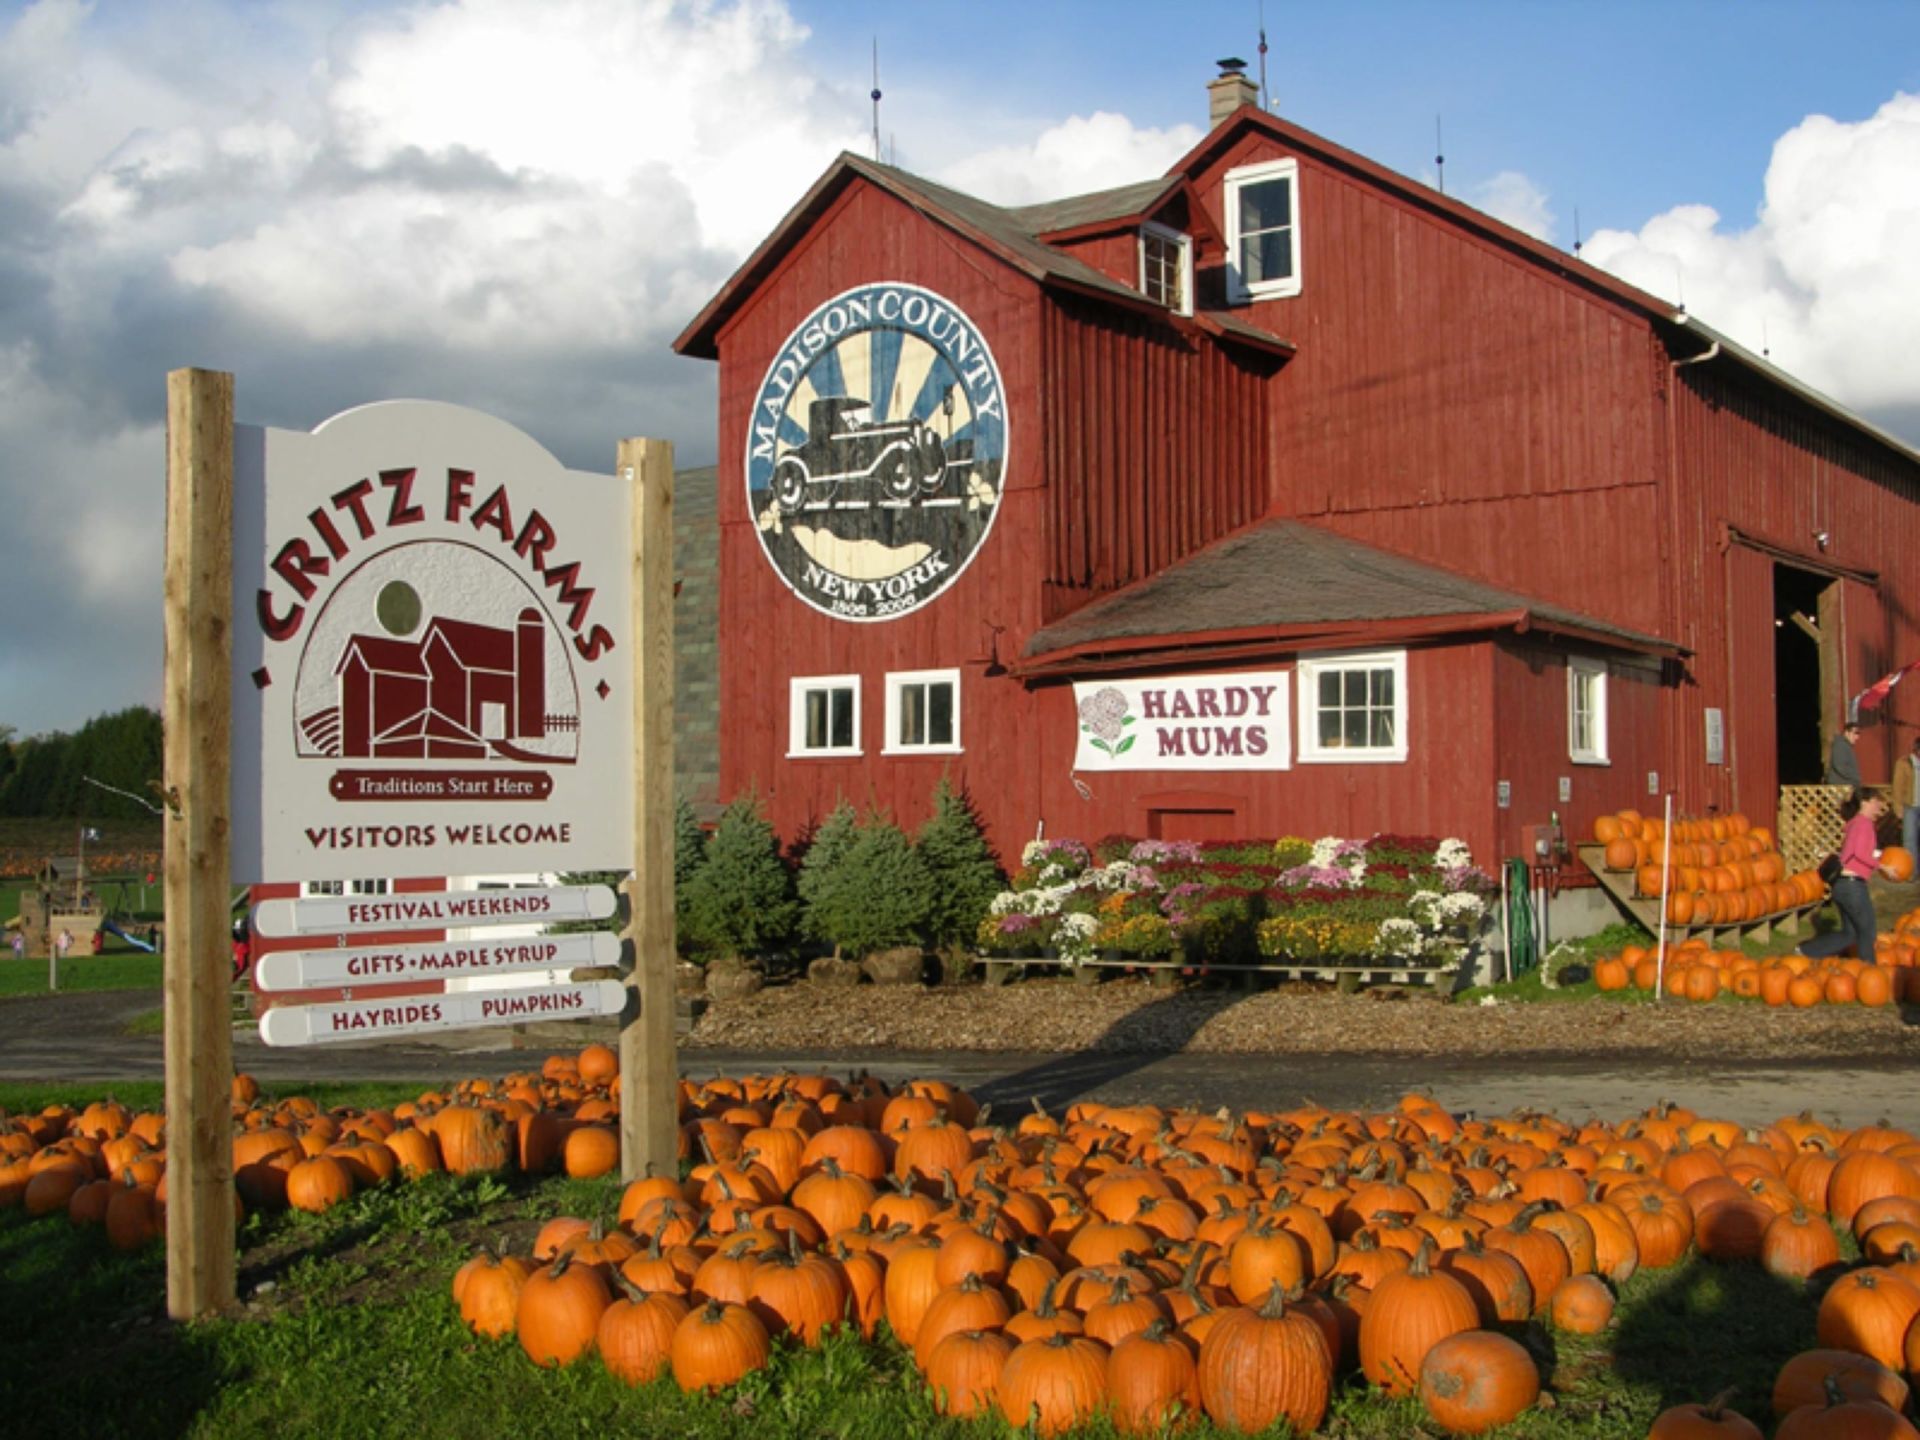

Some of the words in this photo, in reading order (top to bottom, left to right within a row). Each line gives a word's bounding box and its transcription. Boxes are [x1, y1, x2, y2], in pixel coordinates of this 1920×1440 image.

[753, 294, 874, 463] MADISON
[877, 290, 1002, 421] COUNTY
[257, 467, 425, 641] CRITZ
[445, 467, 615, 662] FARMS
[802, 561, 863, 601] NEW
[866, 549, 950, 601] YORK
[1140, 685, 1277, 719] HARDY
[1156, 725, 1269, 757] MUMS
[356, 778, 444, 794] Traditions
[448, 778, 489, 794] Start
[493, 779, 533, 794] Here
[305, 825, 436, 849] VISITORS
[445, 823, 571, 846] WELCOME
[348, 901, 444, 923] FESTIVAL
[447, 895, 551, 916] WEEKENDS
[346, 957, 405, 976] GIFTS
[419, 948, 489, 970] MAPLE
[493, 944, 558, 966] SYRUP
[332, 1004, 442, 1031] HAYRIDES
[481, 991, 584, 1018] PUMPKINS
